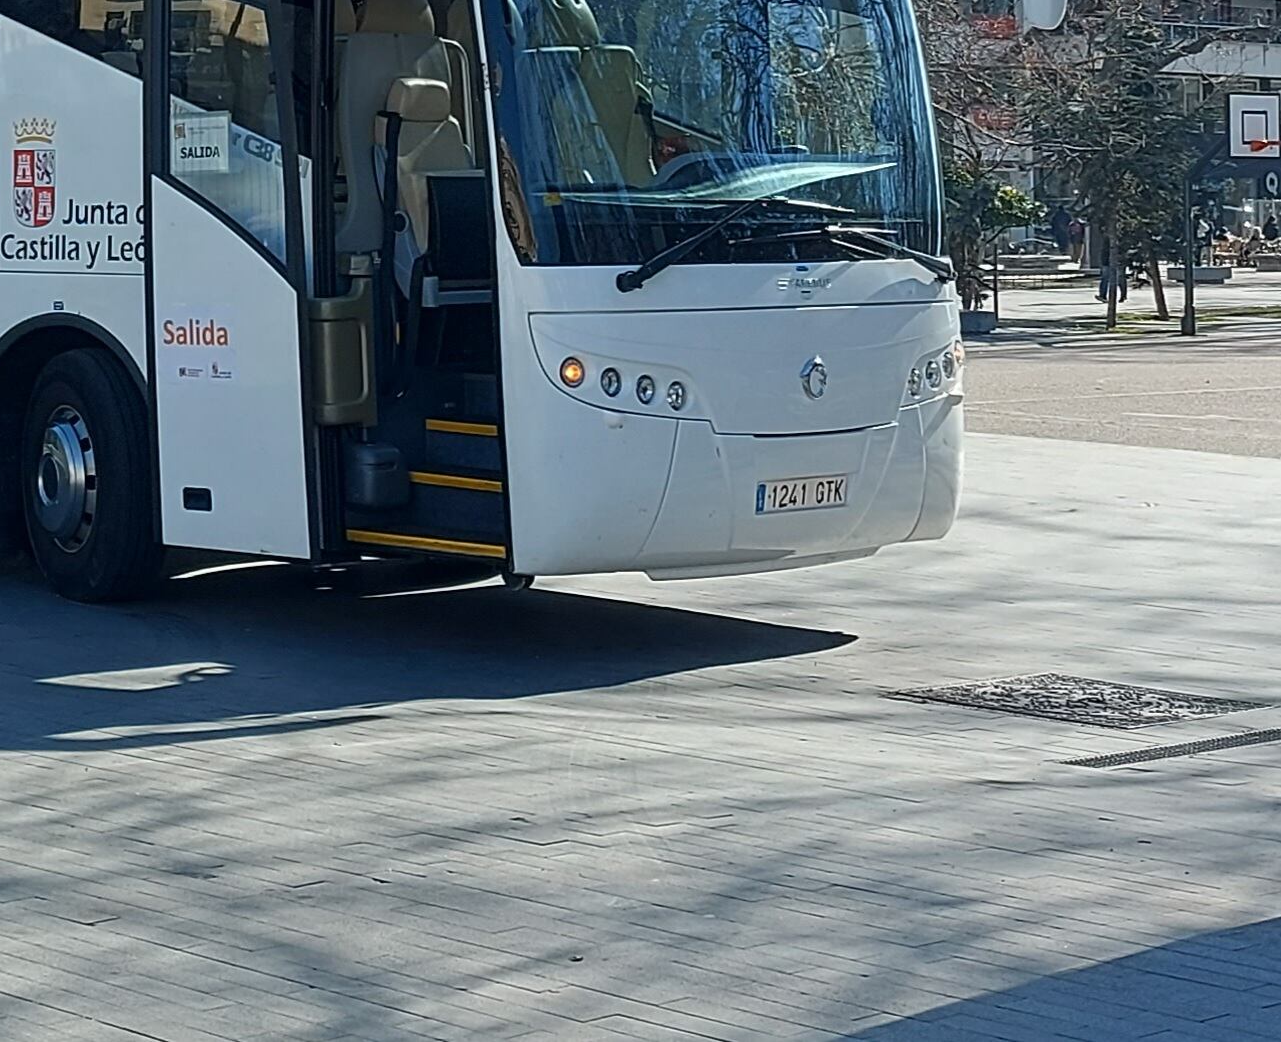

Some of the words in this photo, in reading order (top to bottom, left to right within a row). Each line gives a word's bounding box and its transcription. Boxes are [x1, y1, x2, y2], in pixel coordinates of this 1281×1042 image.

[180, 146, 220, 159] SALIDA
[62, 199, 128, 225] Junta
[0, 234, 80, 261] Castilla
[87, 240, 101, 269] y
[107, 235, 145, 262] Leó
[163, 318, 229, 346] Salida
[771, 483, 807, 509] 1241
[816, 479, 844, 504] GTK
